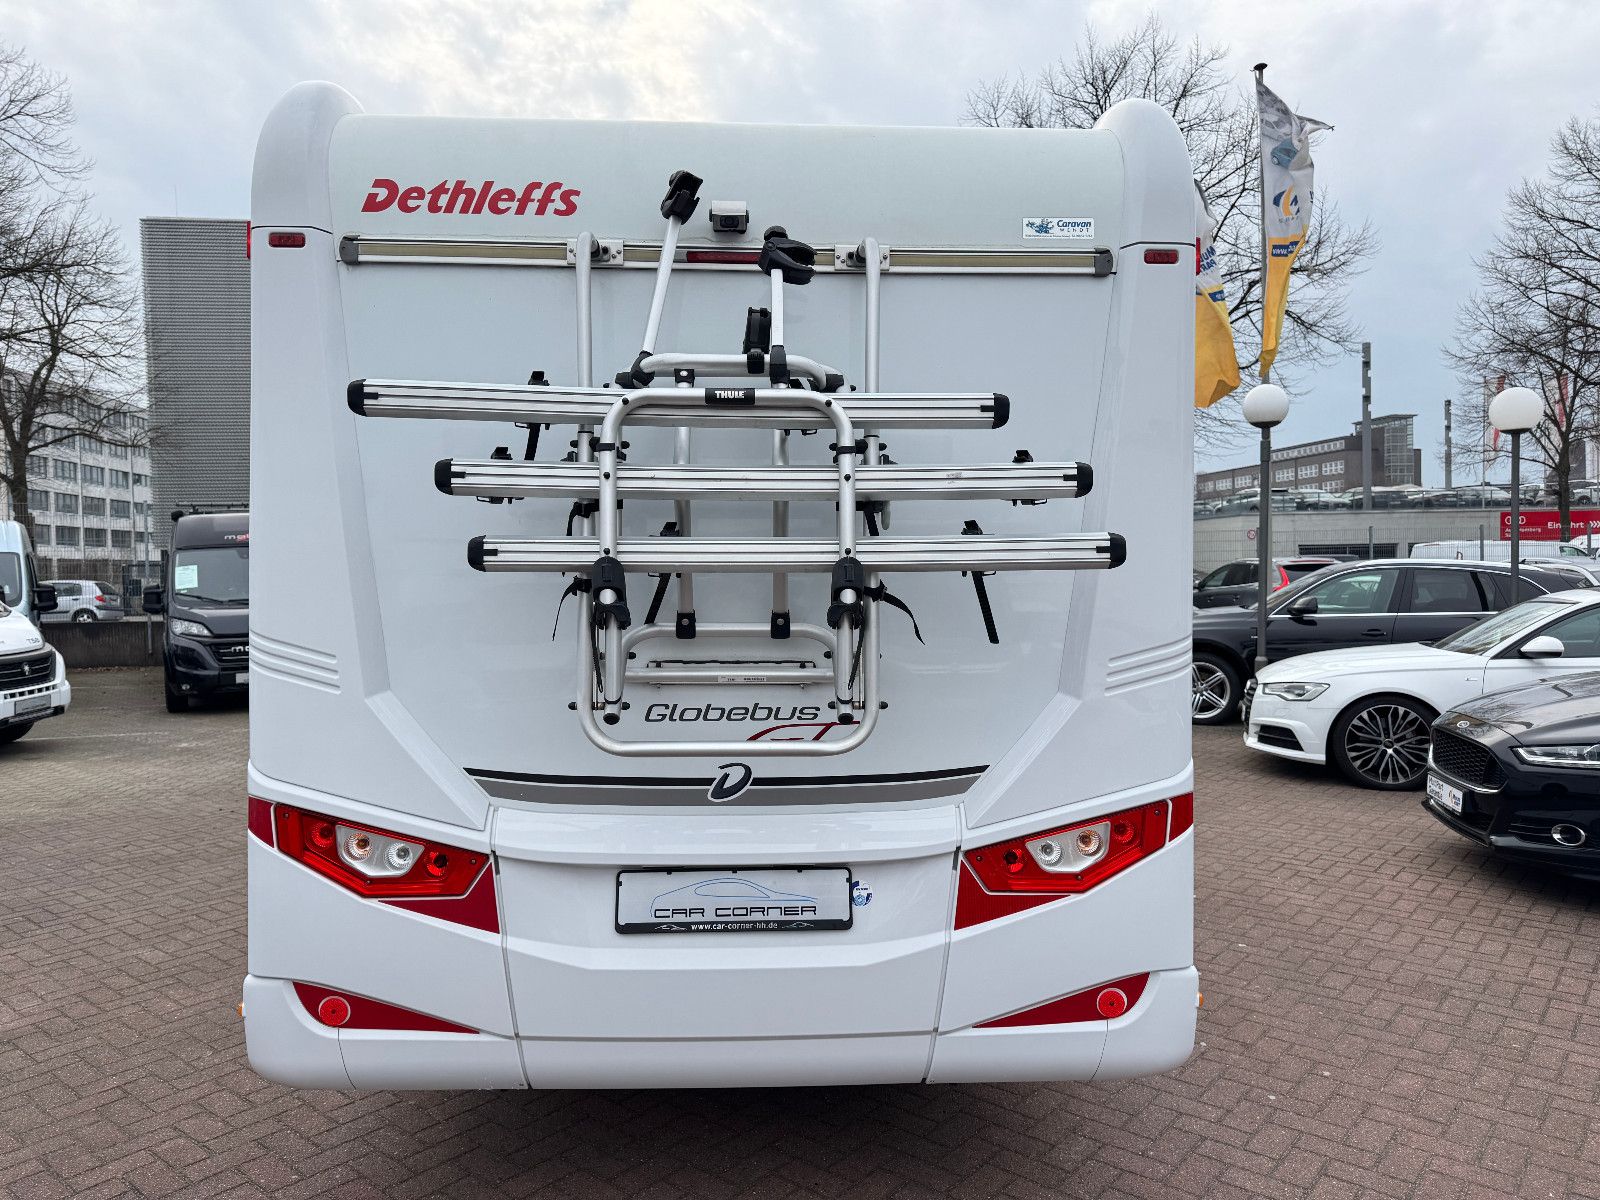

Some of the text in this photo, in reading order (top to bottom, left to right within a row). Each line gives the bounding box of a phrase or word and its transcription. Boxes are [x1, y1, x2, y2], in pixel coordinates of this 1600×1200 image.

[361, 178, 581, 217] Dethleffs
[1056, 219, 1092, 228] Caravan
[714, 390, 746, 399] THULE
[1547, 521, 1585, 529] Einhrt
[644, 702, 821, 723] Globebus
[654, 905, 817, 919] CAR CORNER
[691, 922, 778, 931] www.car-corner-hh.de
